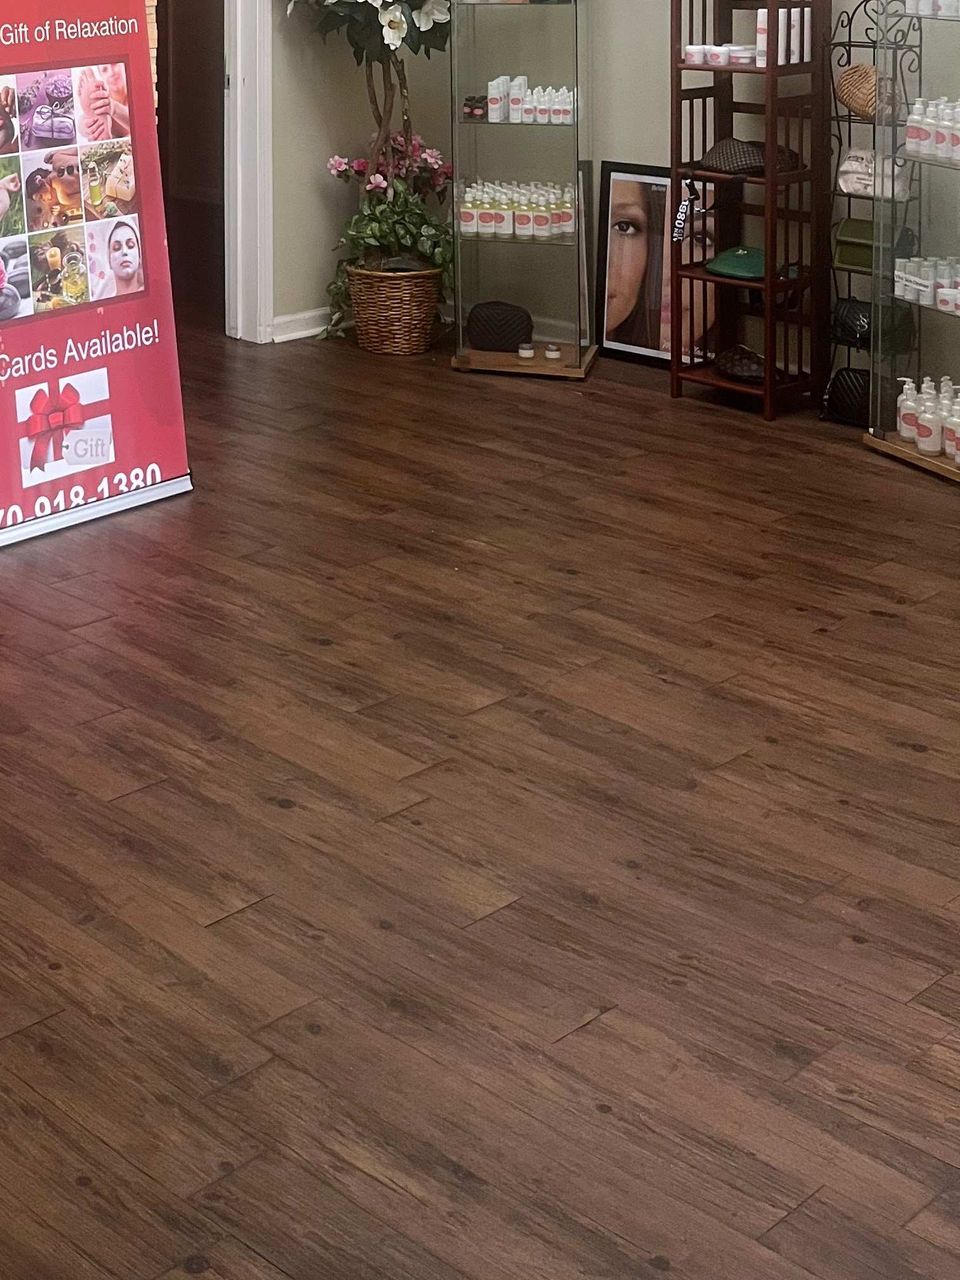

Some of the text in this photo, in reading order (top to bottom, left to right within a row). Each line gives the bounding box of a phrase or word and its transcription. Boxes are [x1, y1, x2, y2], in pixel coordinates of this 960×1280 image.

[0, 23, 30, 46] Gift
[34, 21, 51, 43] of
[55, 16, 138, 40] Relaxation
[64, 319, 160, 365] Available!
[74, 437, 106, 459] Gift
